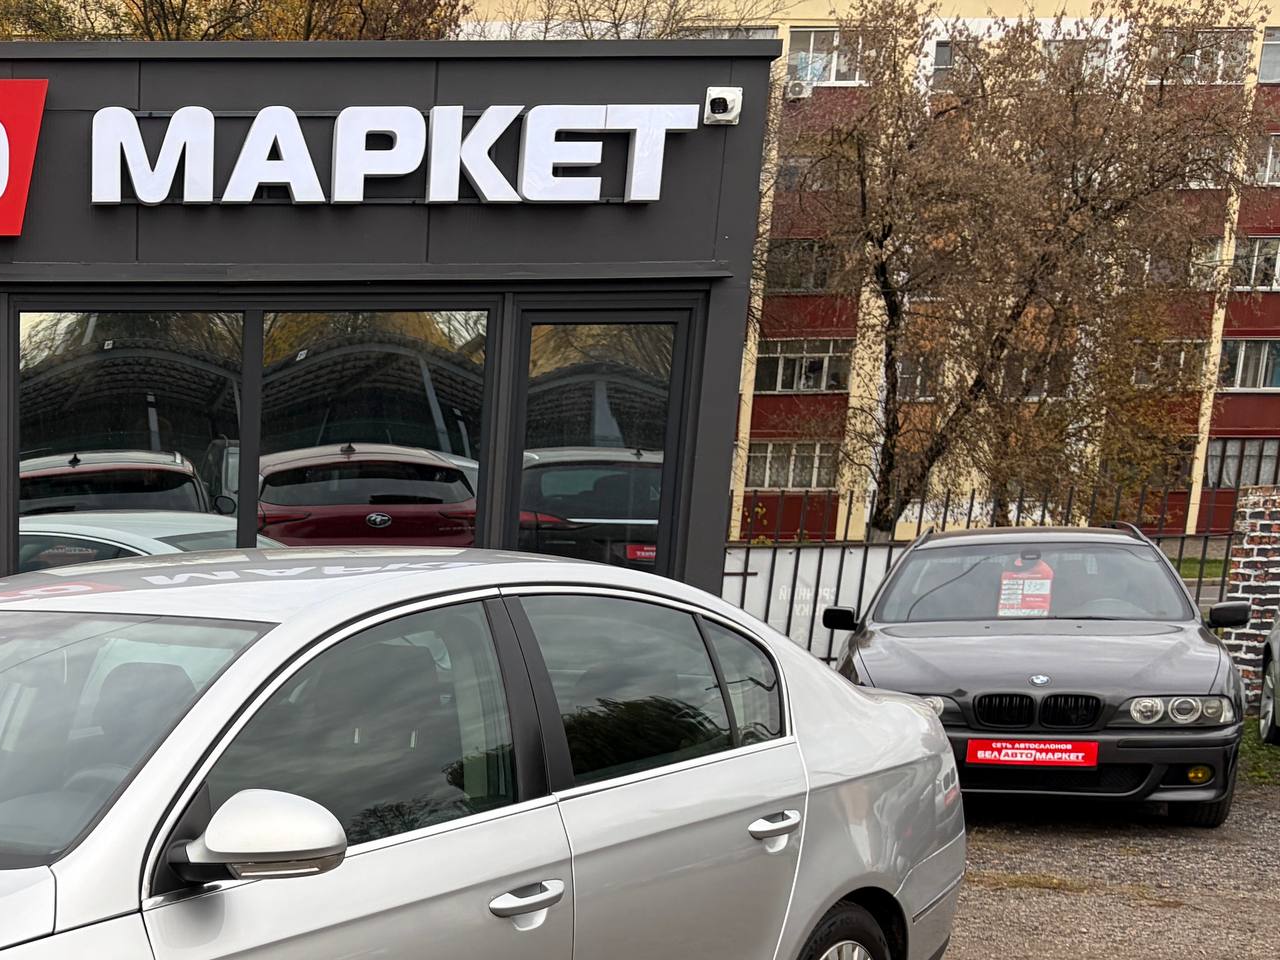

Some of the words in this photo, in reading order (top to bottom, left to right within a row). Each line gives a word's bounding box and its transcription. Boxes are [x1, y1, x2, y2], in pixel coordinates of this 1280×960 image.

[91, 104, 700, 205] МАРКЕТ
[1014, 742, 1072, 750] АВТОСАЛОНОВ
[977, 750, 999, 760] БЕЛ
[1002, 750, 1034, 759] АВТО
[1035, 752, 1085, 761] МАРКЕТ
